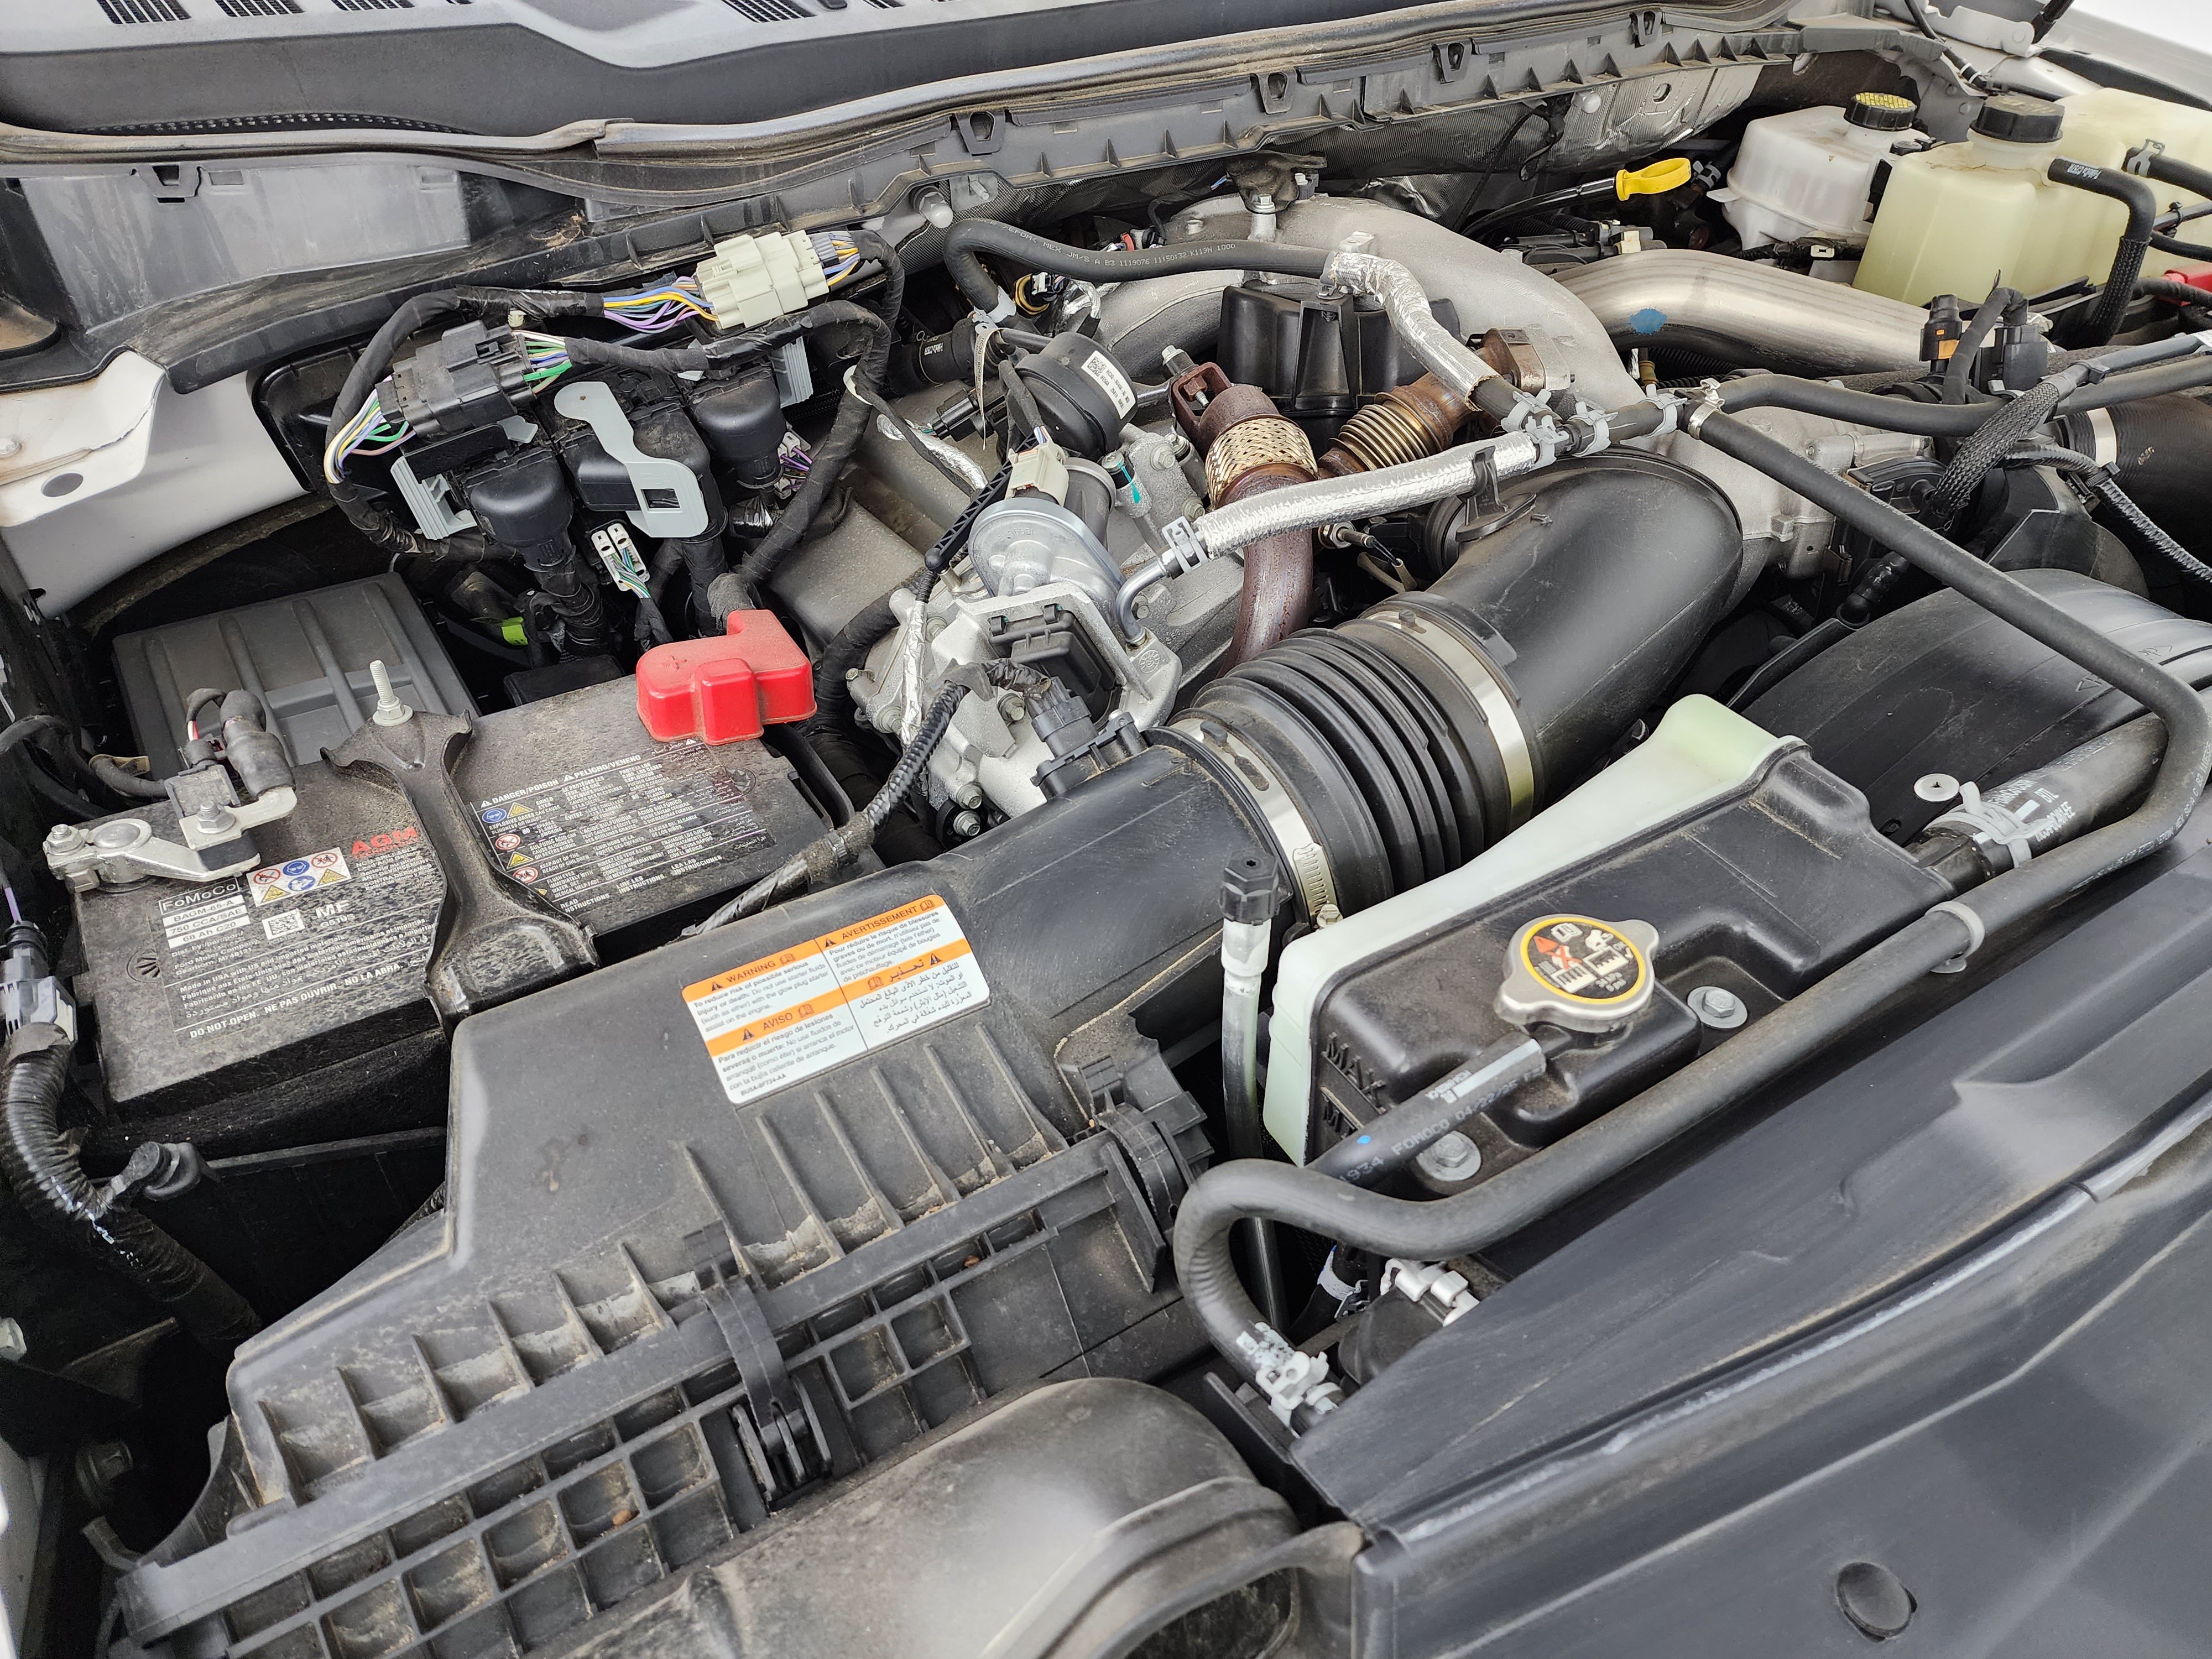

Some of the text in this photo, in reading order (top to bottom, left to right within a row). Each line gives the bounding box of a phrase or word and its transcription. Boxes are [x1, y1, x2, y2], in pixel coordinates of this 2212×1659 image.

[1042, 241, 1062, 254] MEX
[1119, 258, 1150, 267] 1119076
[1154, 252, 1188, 264] 11:50:32
[1217, 243, 1237, 252] 1000
[491, 779, 560, 804] DANGER/POISON
[573, 754, 643, 779] PELIGRO/VENENO
[351, 825, 418, 855] AGM
[163, 881, 237, 911] FoMoCo
[174, 899, 234, 922] BAGM-65-A
[315, 898, 350, 919] MF
[170, 907, 242, 935] 750 CCA/SAE
[182, 921, 237, 942] 68 Ah C20
[829, 946, 846, 956] Pour
[907, 910, 939, 925] blessures
[840, 905, 919, 940] AVERTISSEMENT
[703, 990, 728, 1004] reduce
[729, 985, 743, 994] risk
[782, 960, 808, 974] serious
[726, 959, 776, 983] WARNING
[189, 1026, 205, 1039] DO
[206, 1019, 227, 1034] NOT
[229, 1009, 259, 1026] OPEN.
[264, 1003, 278, 1014] NE
[279, 995, 299, 1009] PAS
[344, 974, 358, 987] NO
[360, 969, 373, 982] LA
[761, 1011, 794, 1030] AVISO
[1391, 1118, 1451, 1156] FOMOCO
